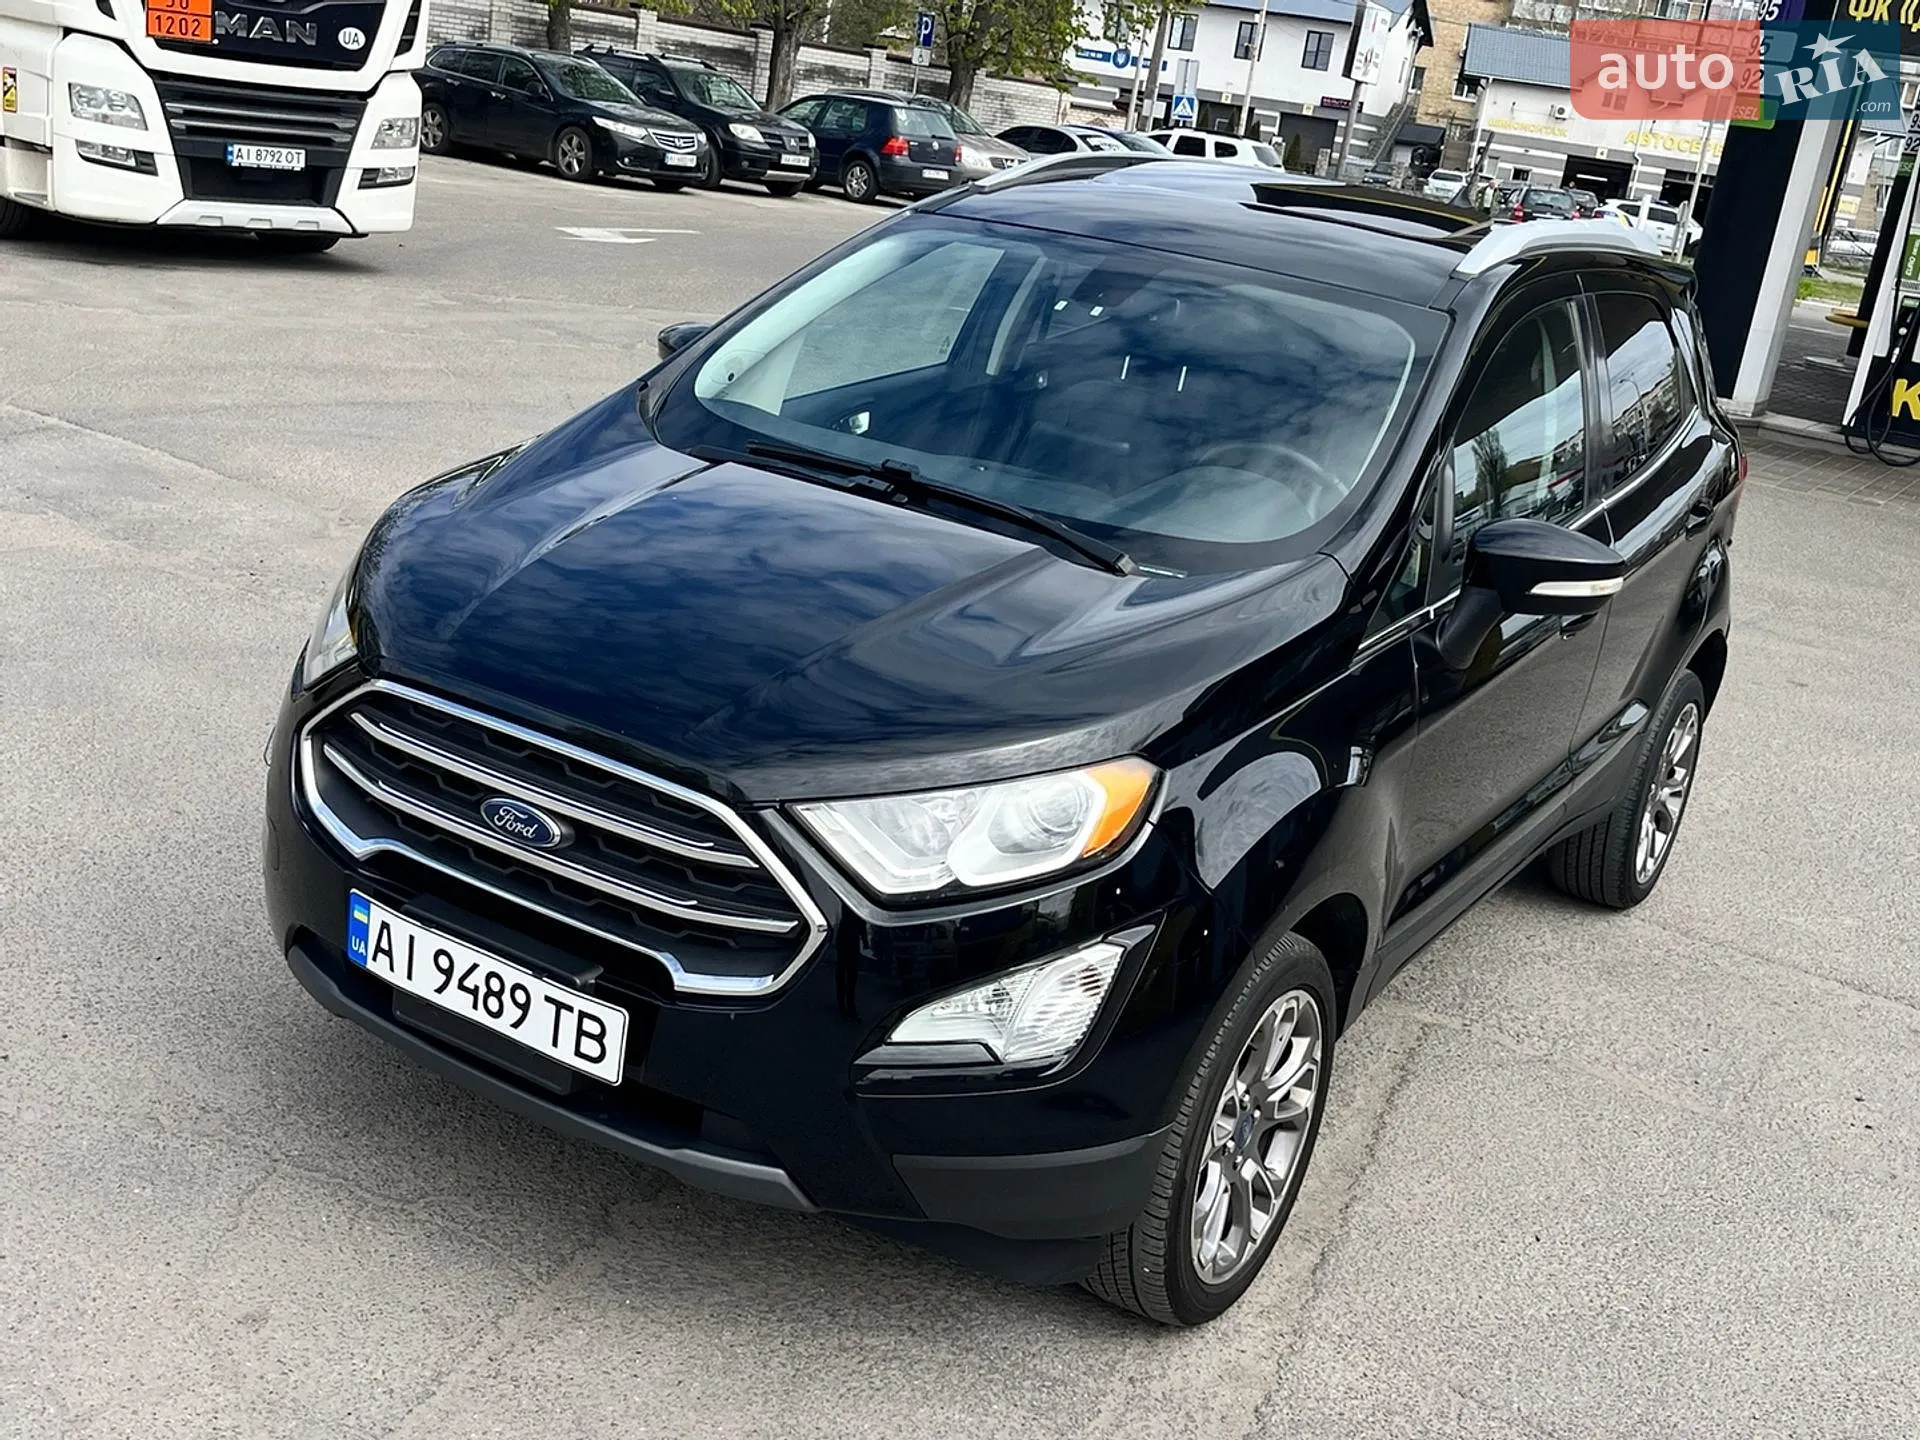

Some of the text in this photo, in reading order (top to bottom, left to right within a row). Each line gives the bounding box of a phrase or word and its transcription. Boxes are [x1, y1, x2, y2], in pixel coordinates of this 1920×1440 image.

[1758, 0, 1782, 21] 95
[155, 14, 201, 37] 1202
[214, 10, 318, 46] MAN
[342, 31, 360, 47] UA
[1748, 34, 1774, 57] 95
[1740, 67, 1764, 90] 92
[235, 147, 303, 165] AI 8792 OT
[494, 806, 539, 839] Ford
[351, 935, 368, 956] UA
[371, 920, 608, 1065] AI 9489 TB
